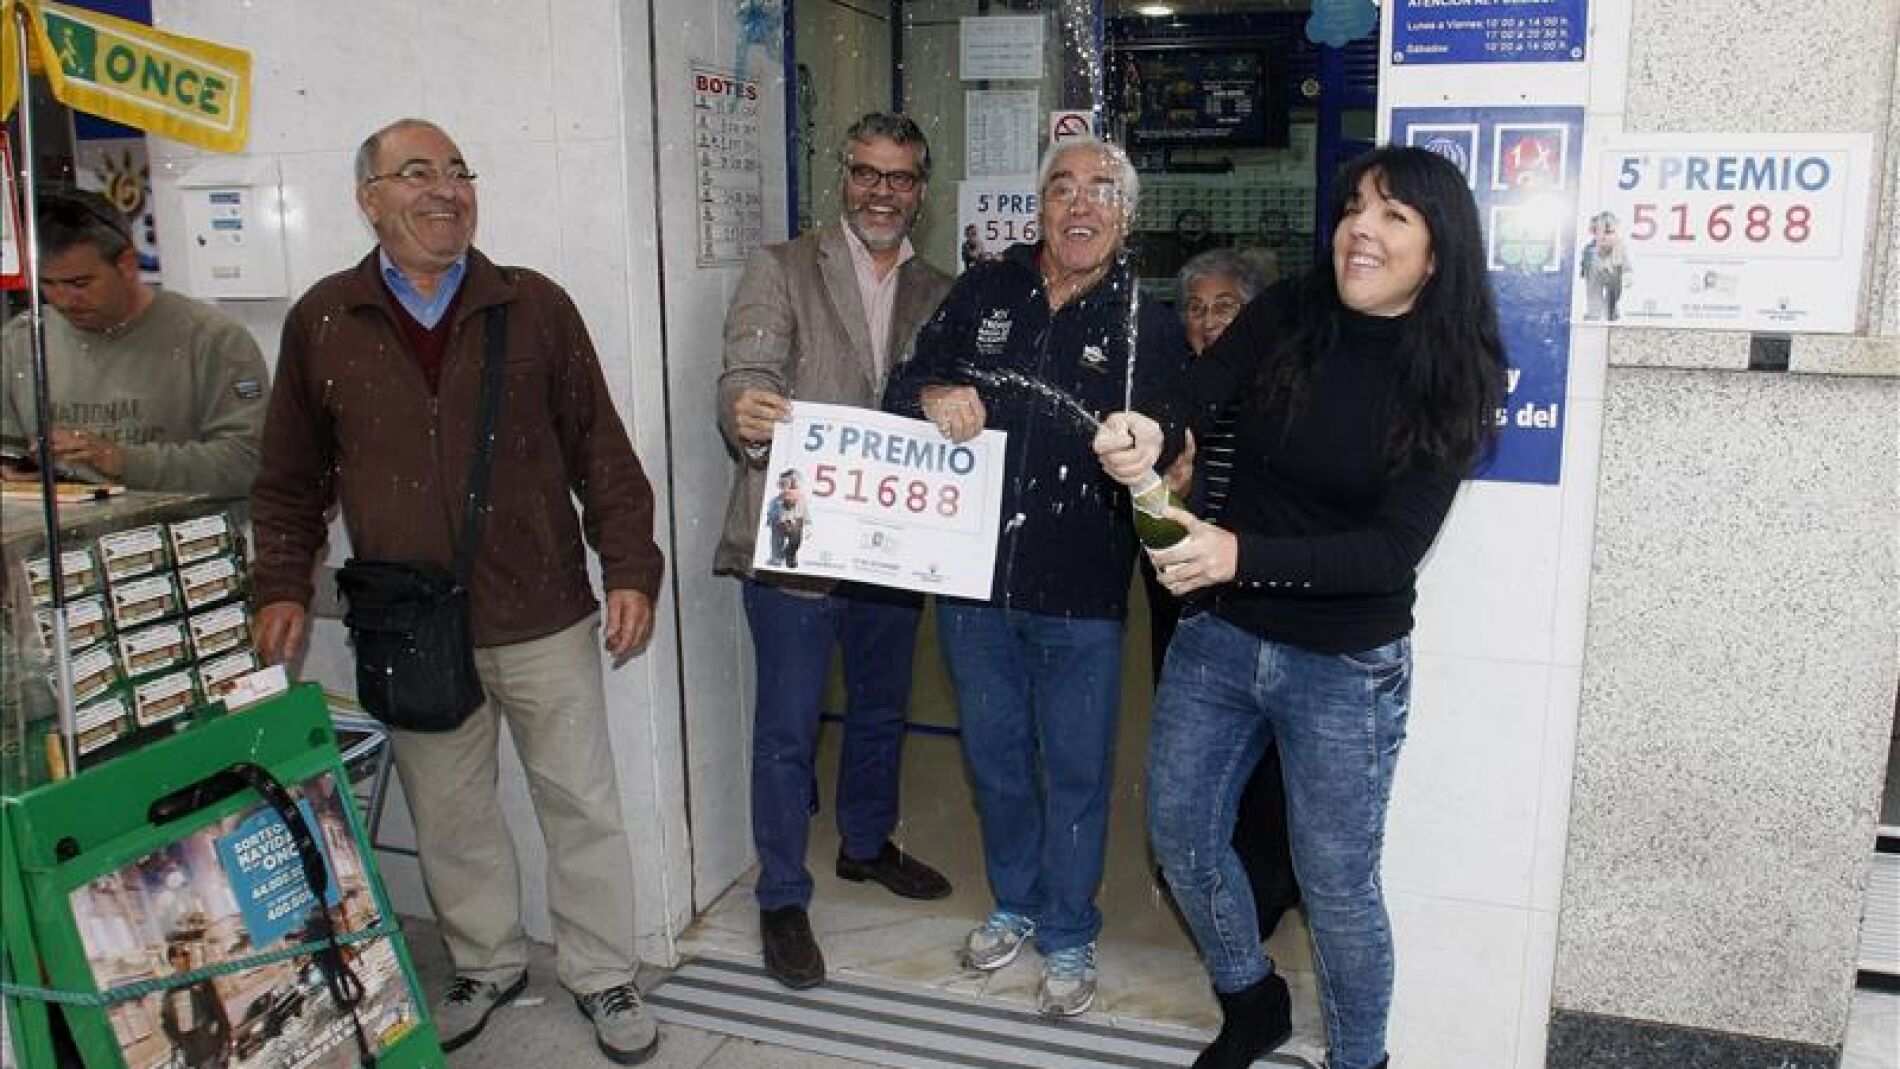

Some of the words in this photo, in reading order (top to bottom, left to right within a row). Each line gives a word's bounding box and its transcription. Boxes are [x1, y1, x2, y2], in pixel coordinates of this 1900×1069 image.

[106, 45, 225, 115] ONCE
[696, 75, 758, 101] BOTES
[1659, 156, 1831, 191] PREMIO
[997, 194, 1037, 214] PRE
[986, 220, 1036, 241] 516
[1631, 204, 1811, 243] 51688
[1516, 402, 1559, 429] del
[839, 426, 975, 475] PREMIO
[811, 464, 960, 517] 51688
[263, 842, 299, 871] ONC
